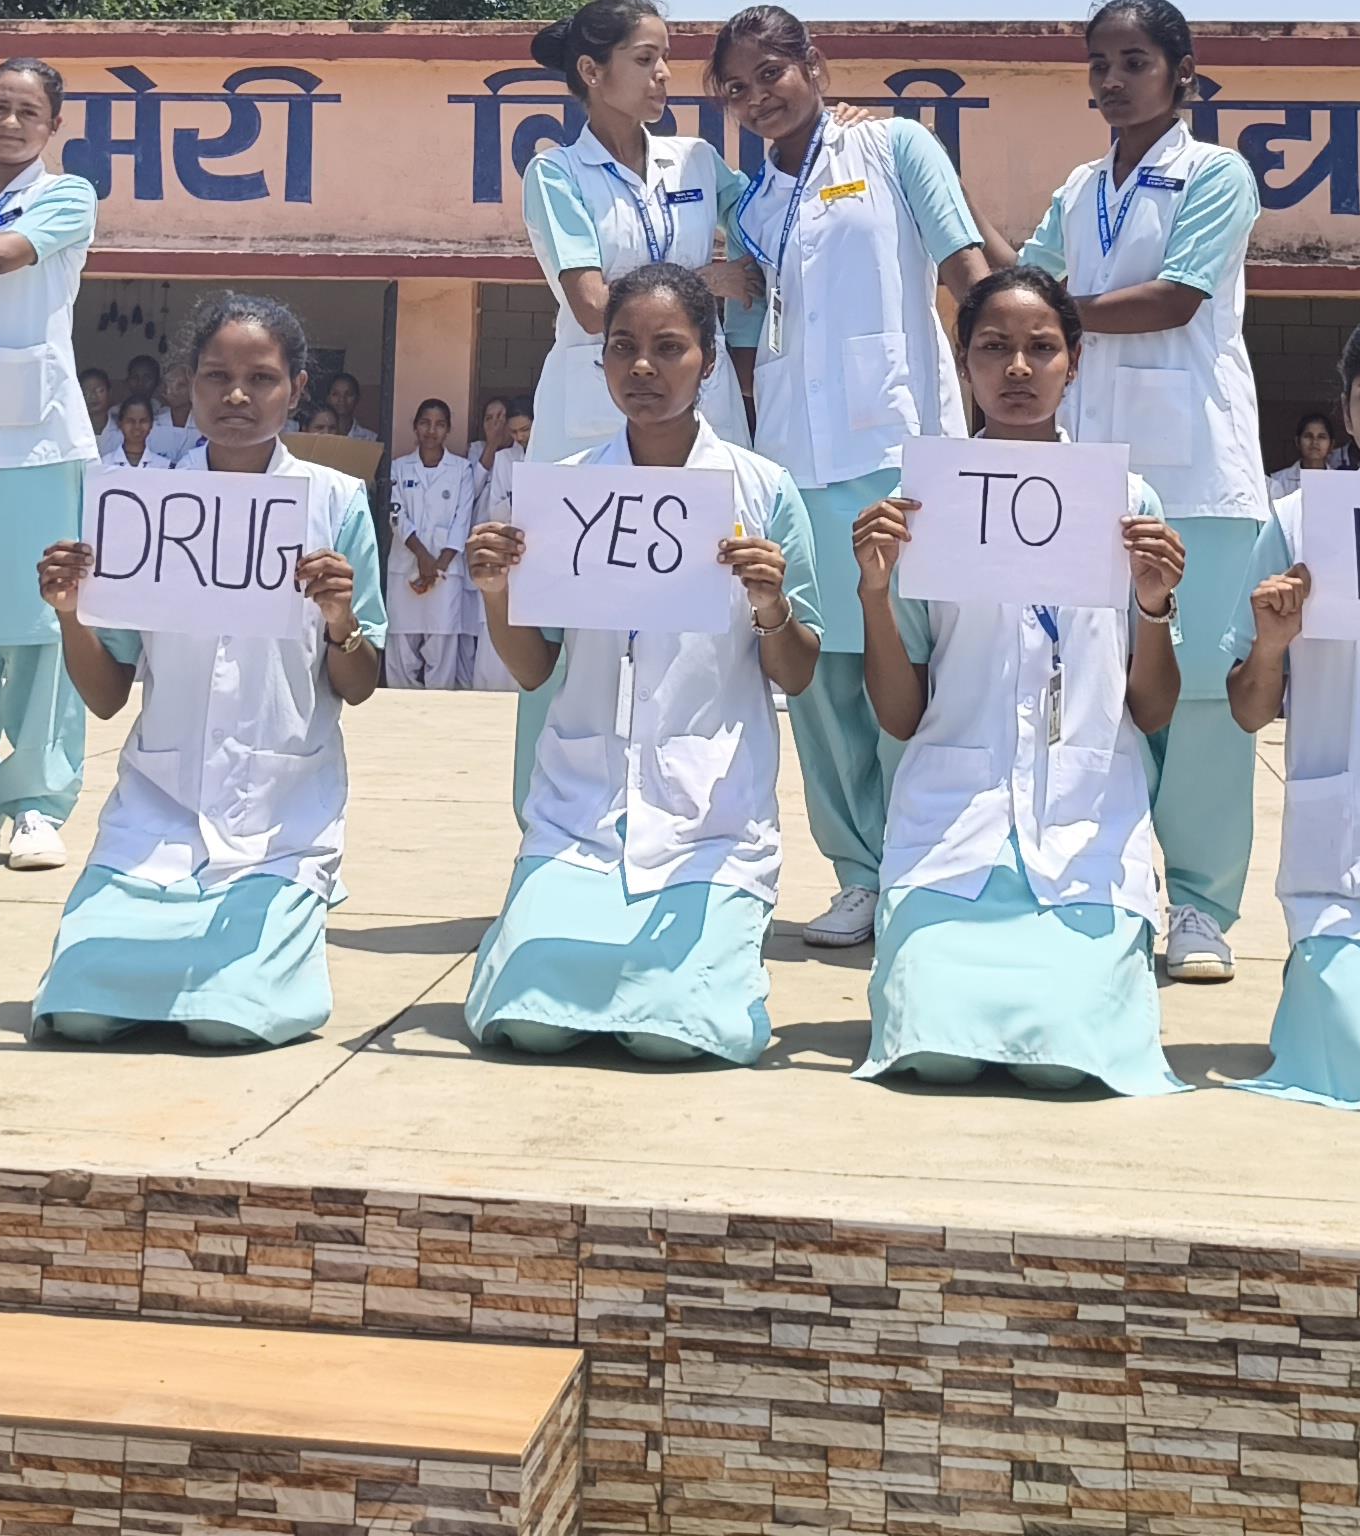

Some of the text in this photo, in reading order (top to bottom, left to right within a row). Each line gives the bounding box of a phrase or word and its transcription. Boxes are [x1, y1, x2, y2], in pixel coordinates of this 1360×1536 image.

[93, 488, 303, 593] DRUG
[562, 491, 688, 577] YES
[958, 470, 1063, 547] TO
